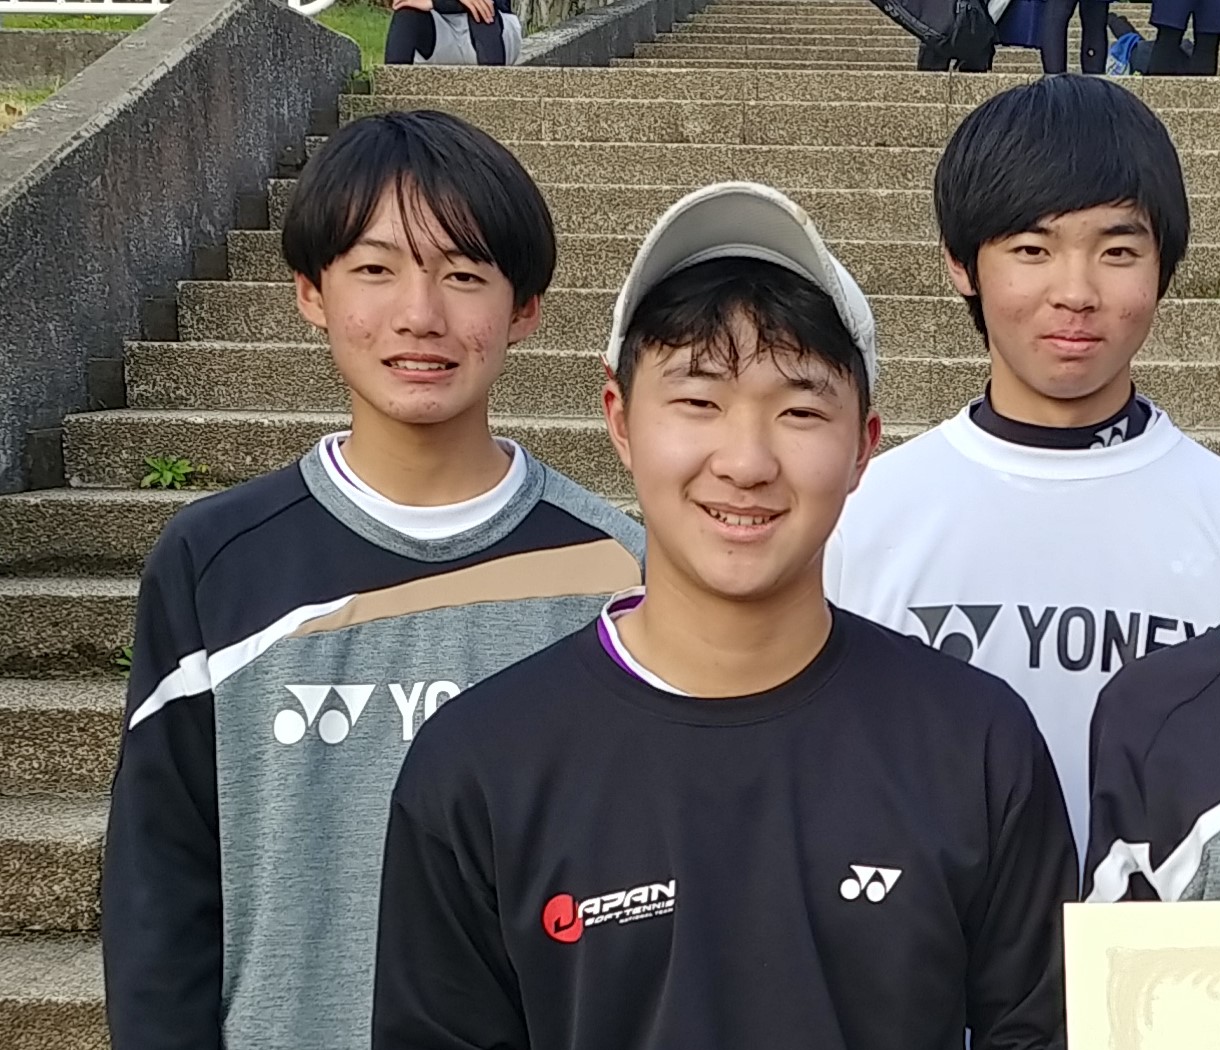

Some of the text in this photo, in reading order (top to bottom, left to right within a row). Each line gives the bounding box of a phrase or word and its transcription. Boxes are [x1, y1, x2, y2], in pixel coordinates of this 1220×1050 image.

[1017, 604, 1196, 673] YONE
[584, 899, 675, 927] SOFT TENNIS
